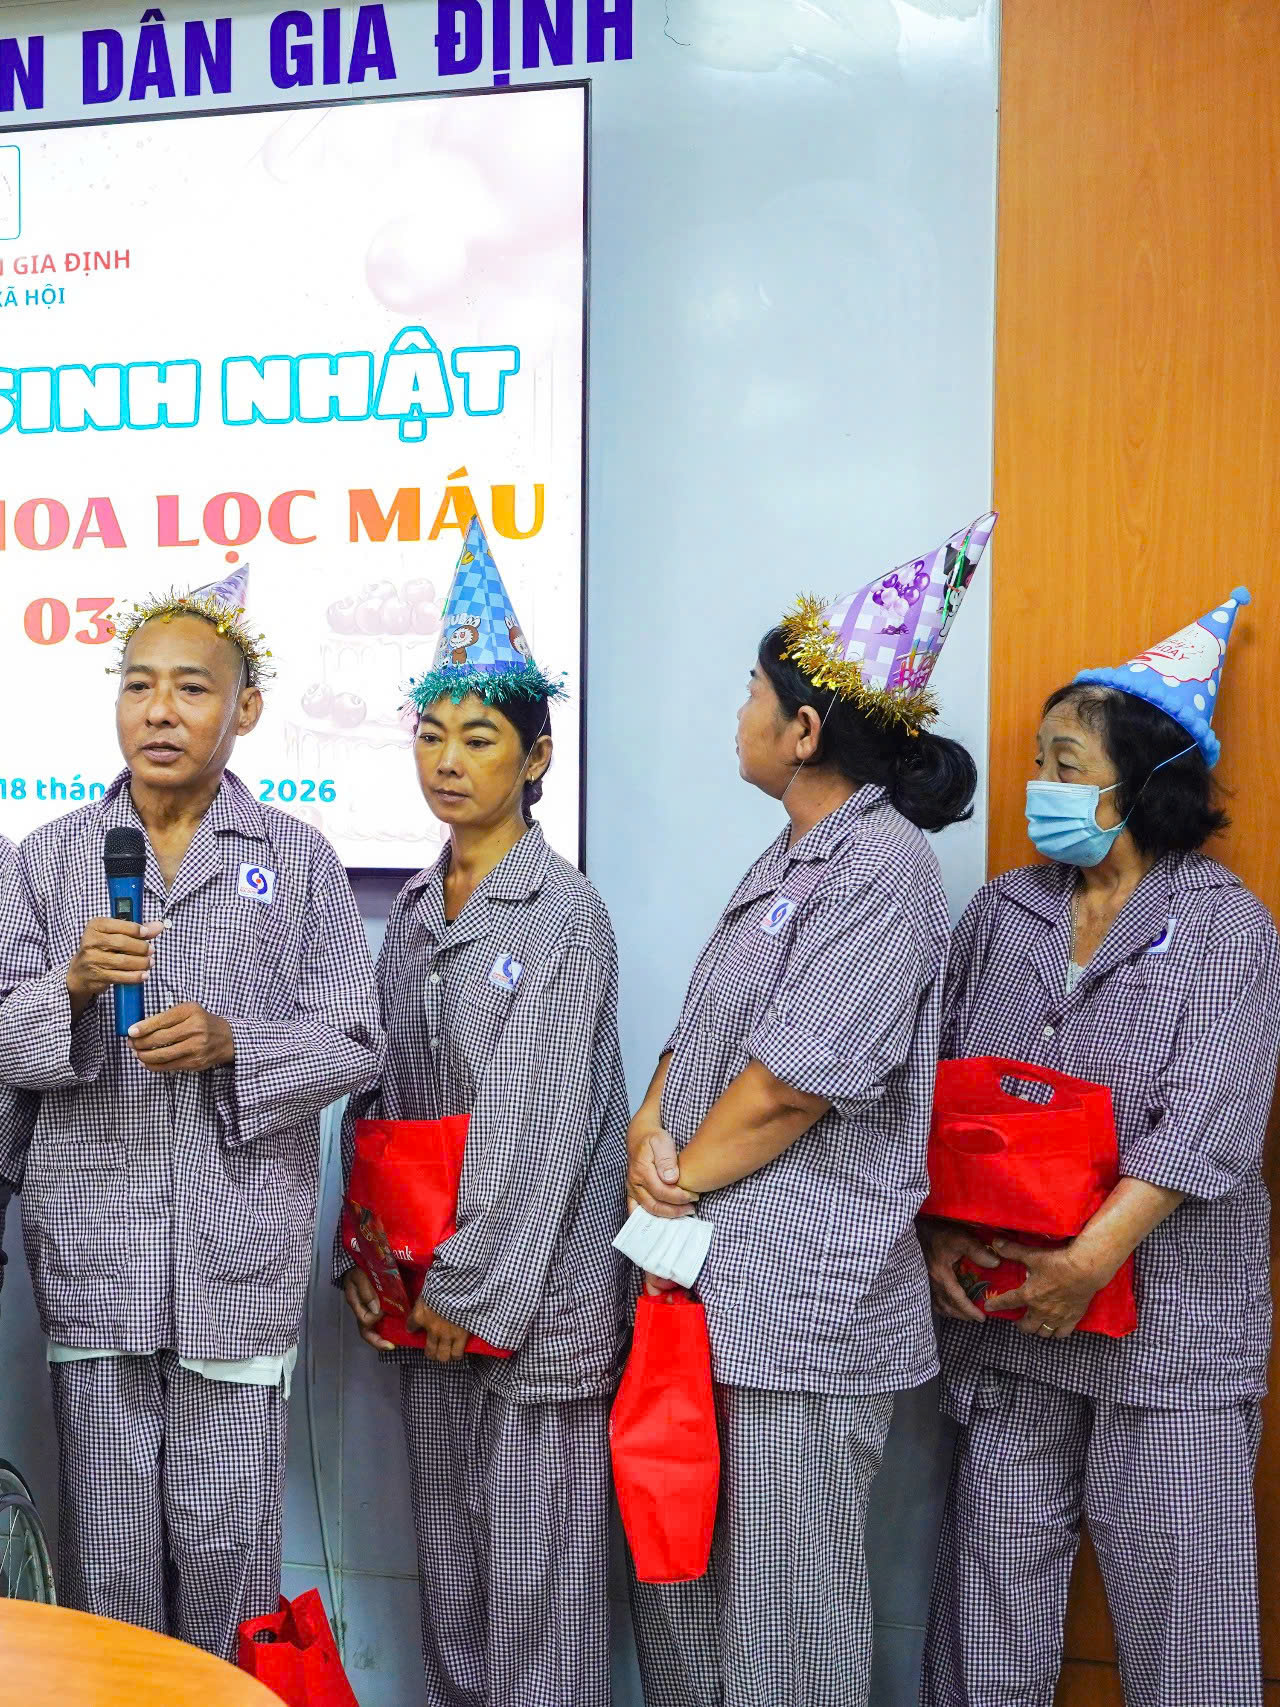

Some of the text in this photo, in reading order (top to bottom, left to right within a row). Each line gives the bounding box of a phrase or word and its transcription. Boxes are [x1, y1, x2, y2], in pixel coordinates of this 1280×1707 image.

[82, 8, 233, 105] DÂN
[269, 4, 397, 89] GIA
[434, 0, 634, 86] ĐỊNH
[13, 254, 56, 275] GIA
[64, 249, 130, 277] ĐỊNH
[25, 283, 65, 310] HỘI
[221, 326, 520, 443] NHẬT
[156, 489, 317, 565] LỌC
[348, 465, 545, 543] MÁU
[23, 596, 117, 646] 03
[36, 773, 106, 801] thán
[259, 778, 337, 803] 2026
